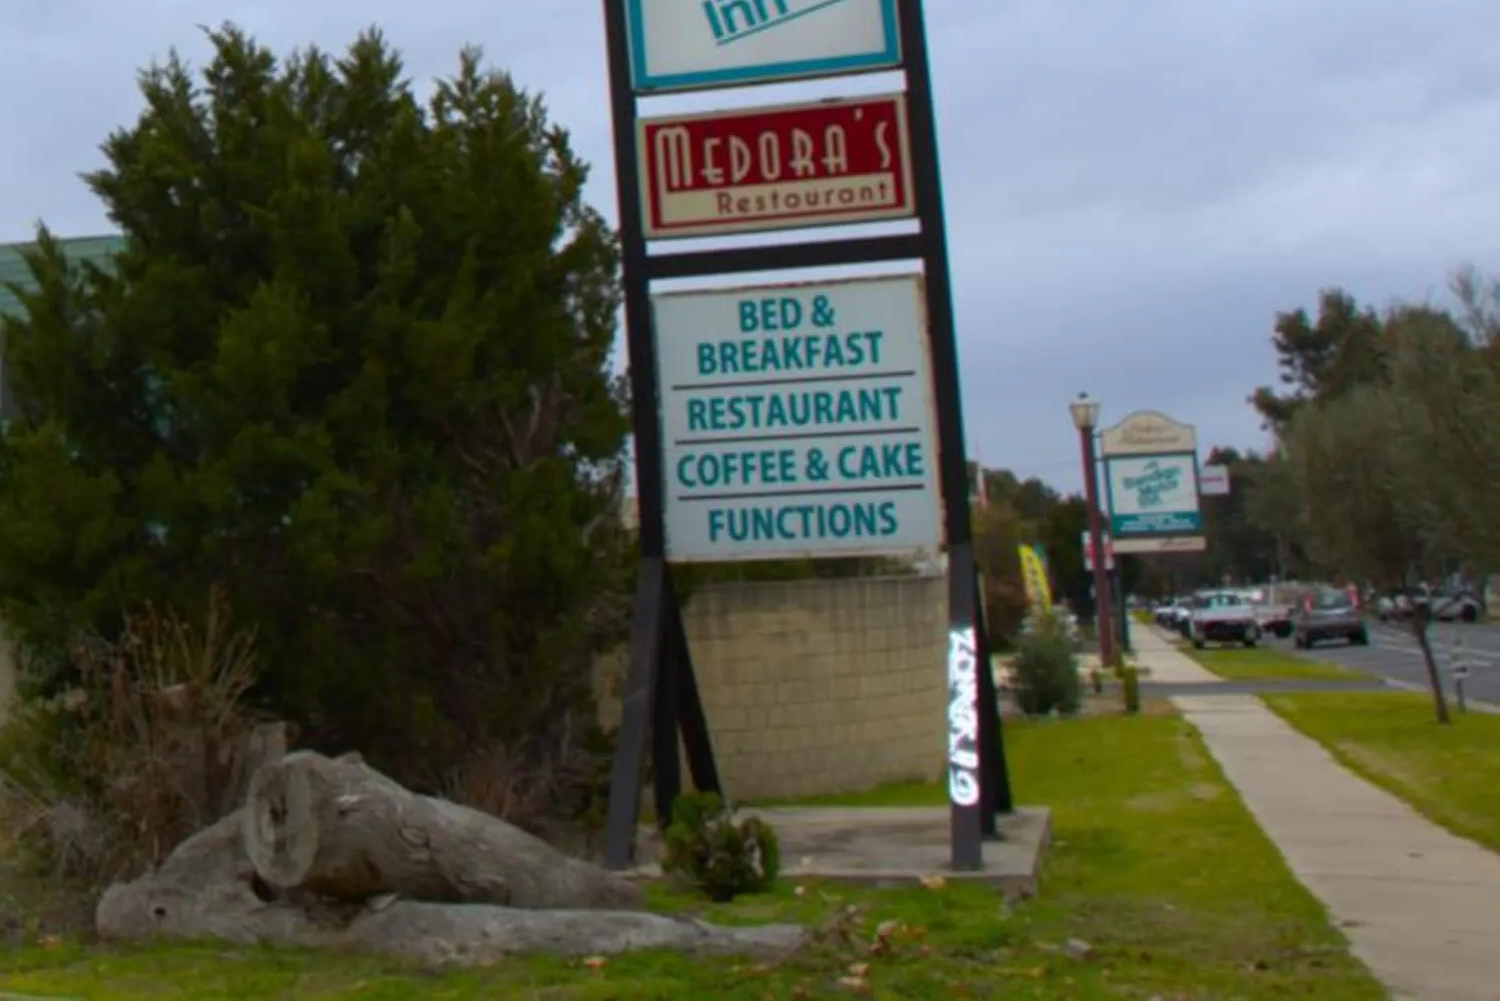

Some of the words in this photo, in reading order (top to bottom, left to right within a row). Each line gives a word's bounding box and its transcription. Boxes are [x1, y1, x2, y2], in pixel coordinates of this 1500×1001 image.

[717, 183, 889, 215] Restaurant
[738, 297, 803, 333] BED
[811, 295, 835, 327] &
[697, 331, 883, 375] BREAKFAST
[687, 387, 901, 431] RESTAURANT
[677, 449, 797, 487] COFFEE
[805, 447, 829, 481] &
[837, 443, 924, 478] CAKE
[708, 502, 897, 542] FUNCTIONS
